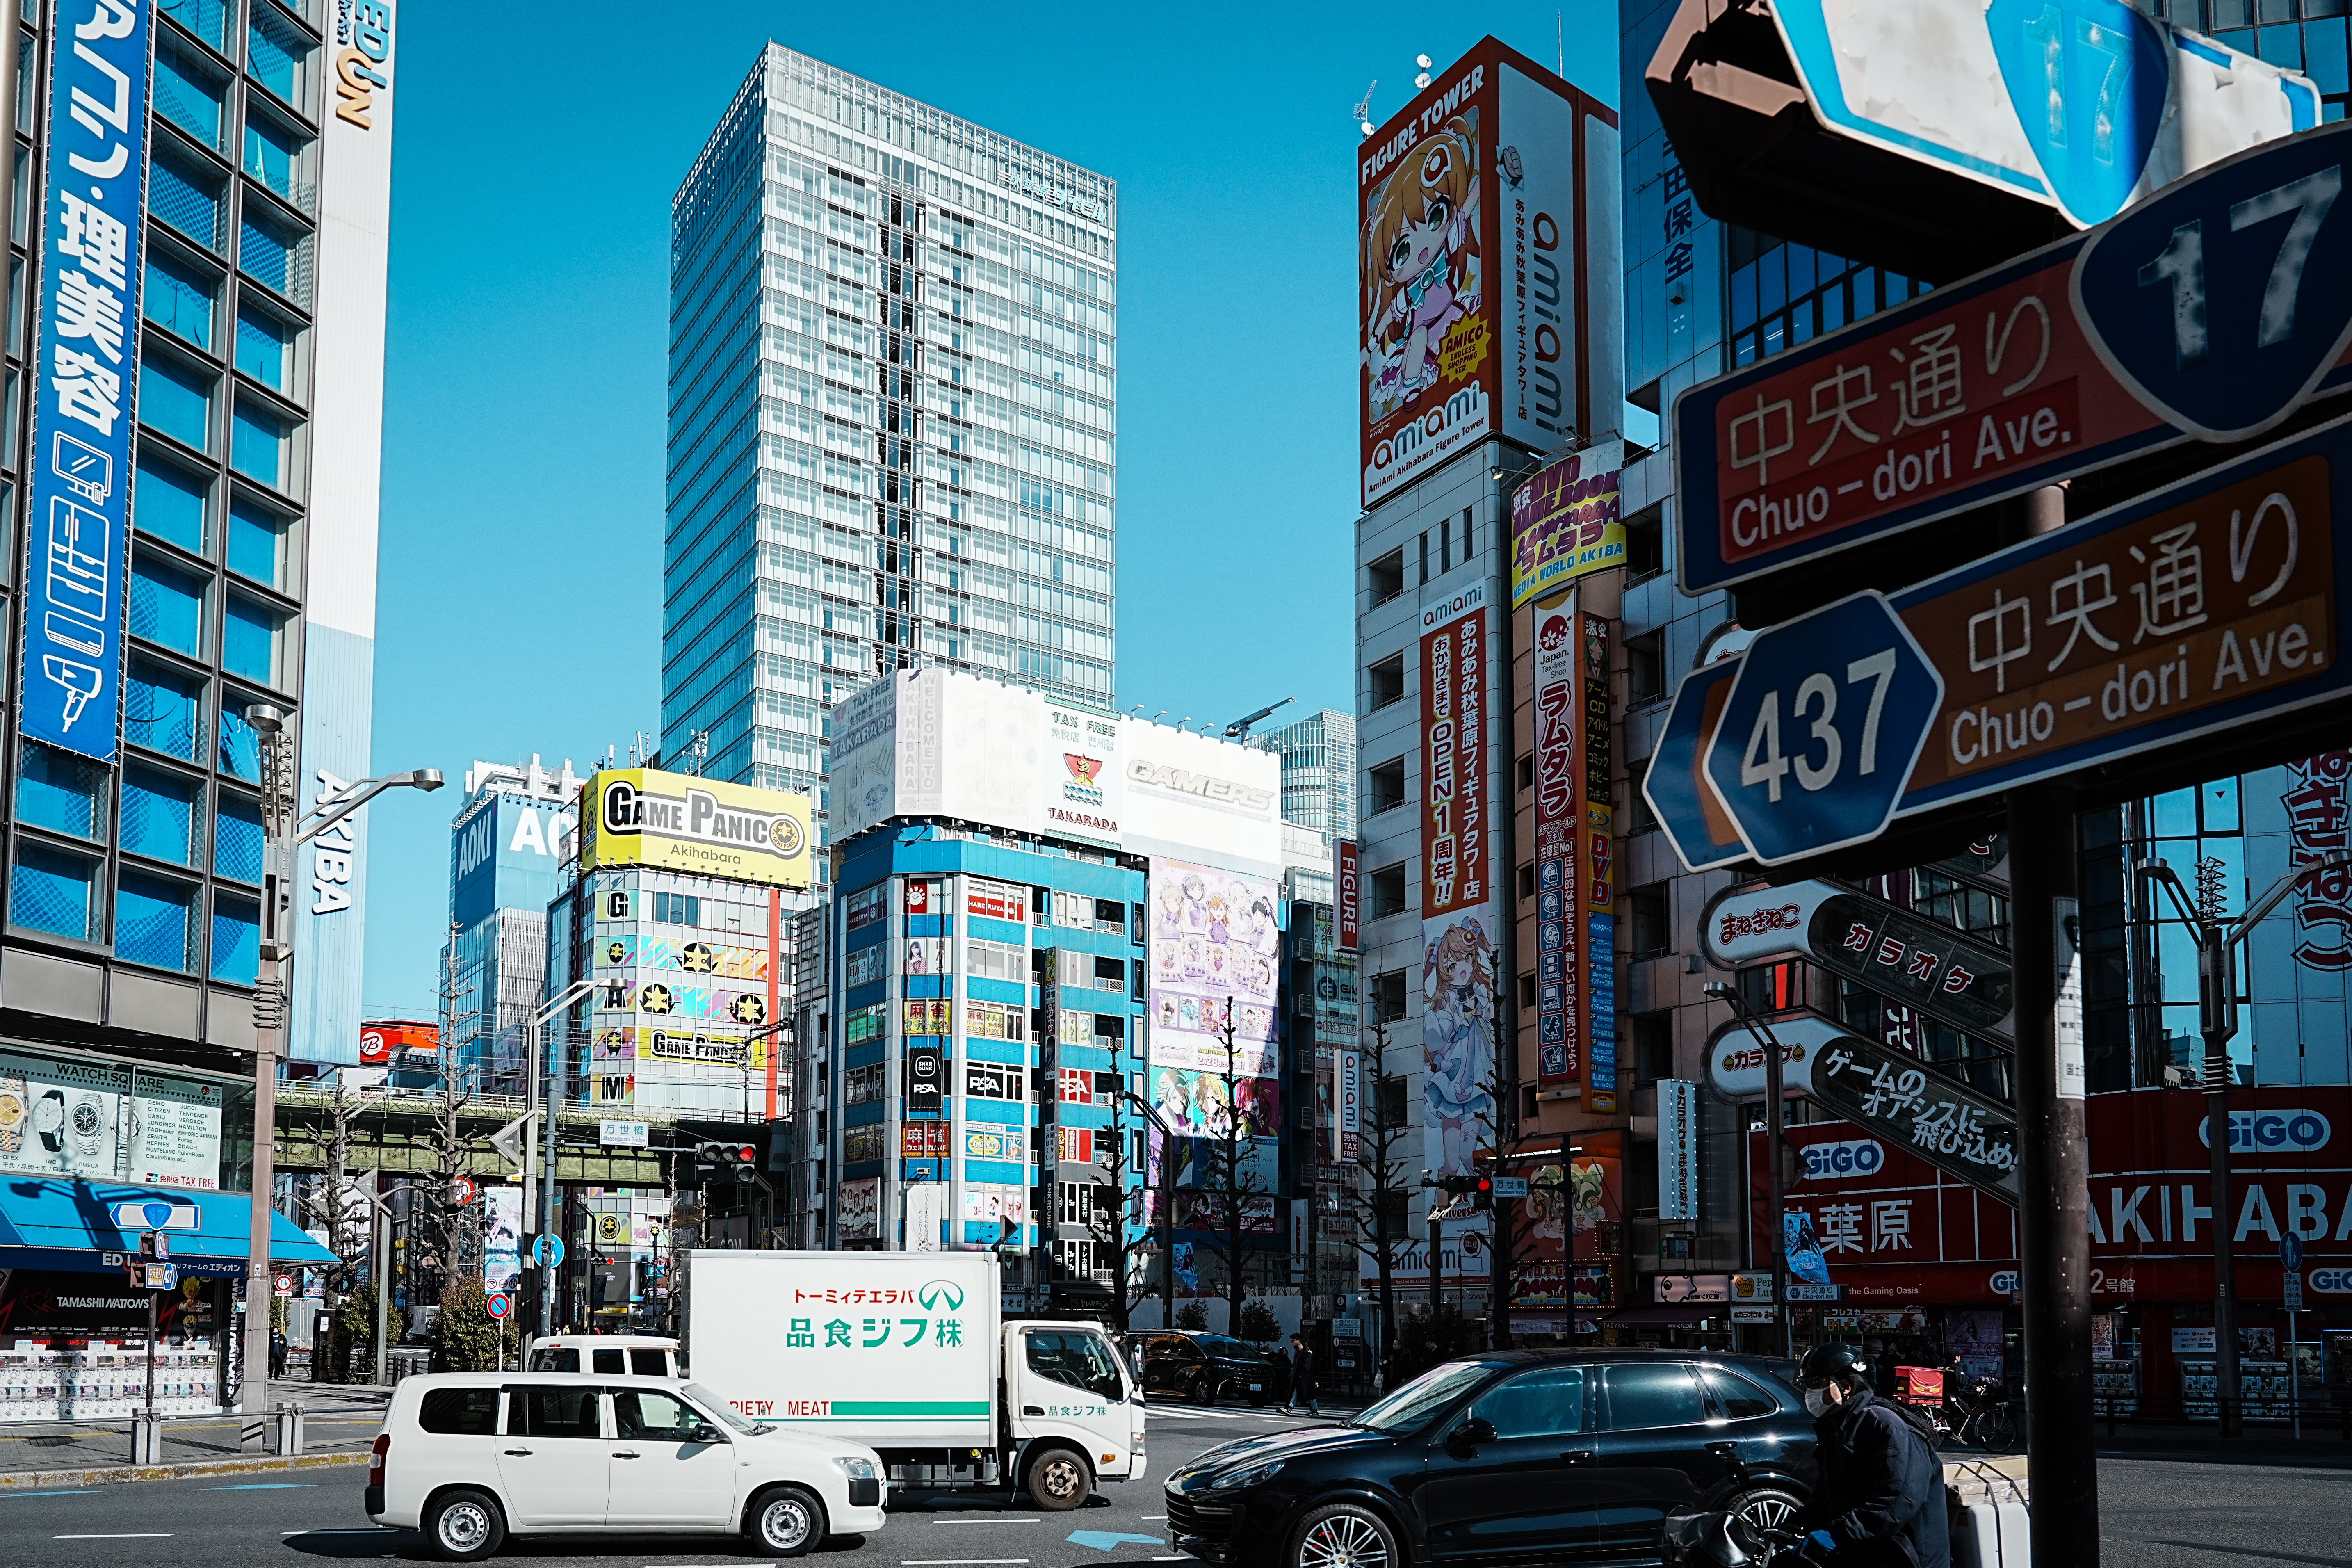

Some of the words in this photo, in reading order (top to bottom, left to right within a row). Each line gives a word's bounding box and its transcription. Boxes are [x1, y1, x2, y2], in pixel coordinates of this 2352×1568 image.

[1362, 119, 1417, 185] FIGURE
[1421, 64, 1483, 134] TOWER
[2138, 163, 2343, 372] 17
[1515, 199, 1528, 421] あみあみ秋葉原フィギュアタワー店
[1533, 212, 1563, 436] amiami
[1445, 325, 1483, 354] AMICO
[1447, 351, 1478, 370] SHOPPING
[1450, 344, 1476, 362] ENDLESS
[1455, 366, 1468, 374] VER.
[1729, 295, 2051, 486] 中央通り
[1370, 422, 1390, 439] miyajima
[1375, 385, 1480, 470] amiami
[1974, 405, 2071, 470] Ave.
[1369, 471, 1395, 494] AmiAmi
[1397, 449, 1433, 480] Akihabara
[1435, 432, 1460, 456] Figure
[1462, 417, 1485, 438] Tower
[1531, 455, 1581, 502] DVD
[1559, 470, 1620, 509] BOOK
[1522, 520, 1604, 577] ラムタラ
[1513, 576, 1536, 601] MEDIA
[1540, 555, 1575, 581] WORLD
[1579, 543, 1623, 565] AKIBA
[1968, 492, 2299, 693] 中央通り
[1424, 586, 1482, 626] amiami
[1585, 620, 1607, 638] 激安
[1540, 649, 1569, 665] Japan.
[1542, 660, 1566, 676] Tax-free
[2213, 621, 2326, 692] Ave.
[1550, 668, 1566, 678] Shop
[853, 678, 890, 710] TAX-FREE
[1587, 681, 1608, 698] ゲーム
[922, 674, 937, 758] WELCOME
[1590, 700, 1606, 714] CD
[833, 712, 893, 757] TAKARADA
[904, 681, 917, 789] AKIHABARA
[1053, 712, 1078, 727] TAX
[1086, 720, 1116, 736] FREE
[1588, 716, 1608, 732] アイドル
[1740, 648, 1897, 803] 437
[1539, 680, 1572, 817] ラムタラ
[1588, 734, 1609, 749] アニメ
[1460, 619, 1481, 900] あみあみ秋葉原フィギュアタワー店
[1588, 753, 1608, 767] コミック
[923, 765, 935, 789] TO
[1127, 758, 1275, 811] GAMERS
[1589, 769, 1608, 783] ホビー
[1588, 787, 1609, 802] フィギュア
[608, 786, 682, 831] GAME
[691, 794, 767, 843] PANIC
[1047, 807, 1118, 832] TAKARADA
[1539, 816, 1576, 836] メディアワールド
[313, 769, 356, 913] AKIBA
[458, 810, 492, 881] AOKI
[1547, 830, 1564, 843] アキバ
[671, 844, 741, 865] Akihabara
[1591, 834, 1610, 904] DVD
[1343, 856, 1355, 934] FIGURE
[1721, 904, 1800, 945] まねきねこ
[849, 960, 867, 978] 耳かき
[1564, 856, 1577, 1070] 圧倒的な品ぞろえ。新しい何かを見つけよう
[1843, 922, 1974, 993] カラオケ
[1046, 991, 1056, 1000] 麻雀
[909, 1002, 946, 1018] 麻雀
[968, 1011, 983, 1020] 麻雀
[56, 1064, 107, 1080] WATCH
[110, 1072, 164, 1089] SQUARE
[969, 1077, 1001, 1091] PSA
[1825, 1049, 1926, 1098] ゲームの
[914, 1083, 938, 1093] PSA
[1345, 1055, 1355, 1127] amiami
[179, 1111, 208, 1119] TENDENCE
[1677, 1095, 1687, 1140] カラオケ
[1862, 1091, 1986, 1134] オアシスに
[605, 1124, 644, 1136] 万世橋
[907, 1129, 945, 1143] 麻雀
[1344, 1132, 1357, 1142] 免税
[1802, 1144, 1881, 1175] GiGO
[160, 1175, 179, 1184] 免税店
[181, 1176, 214, 1188] TAX-FREE
[1496, 1180, 1525, 1189] 万世橋
[1678, 1152, 1688, 1215] まねきねこ
[967, 1194, 974, 1204] 2F
[974, 1206, 981, 1216] 3F
[1465, 1239, 1477, 1248] 消火栓
[164, 1269, 173, 1283] 437
[209, 1263, 240, 1272] エディオン
[1848, 1287, 1861, 1295] the
[1863, 1287, 1894, 1296] Gaming
[1896, 1286, 1919, 1295] Oasis
[2090, 1269, 2135, 1294] 2号館
[57, 1297, 104, 1308] TAMASHII
[105, 1298, 149, 1308] NATIONS
[1827, 1318, 1841, 1332] B1
[788, 1401, 830, 1416] MEAT
